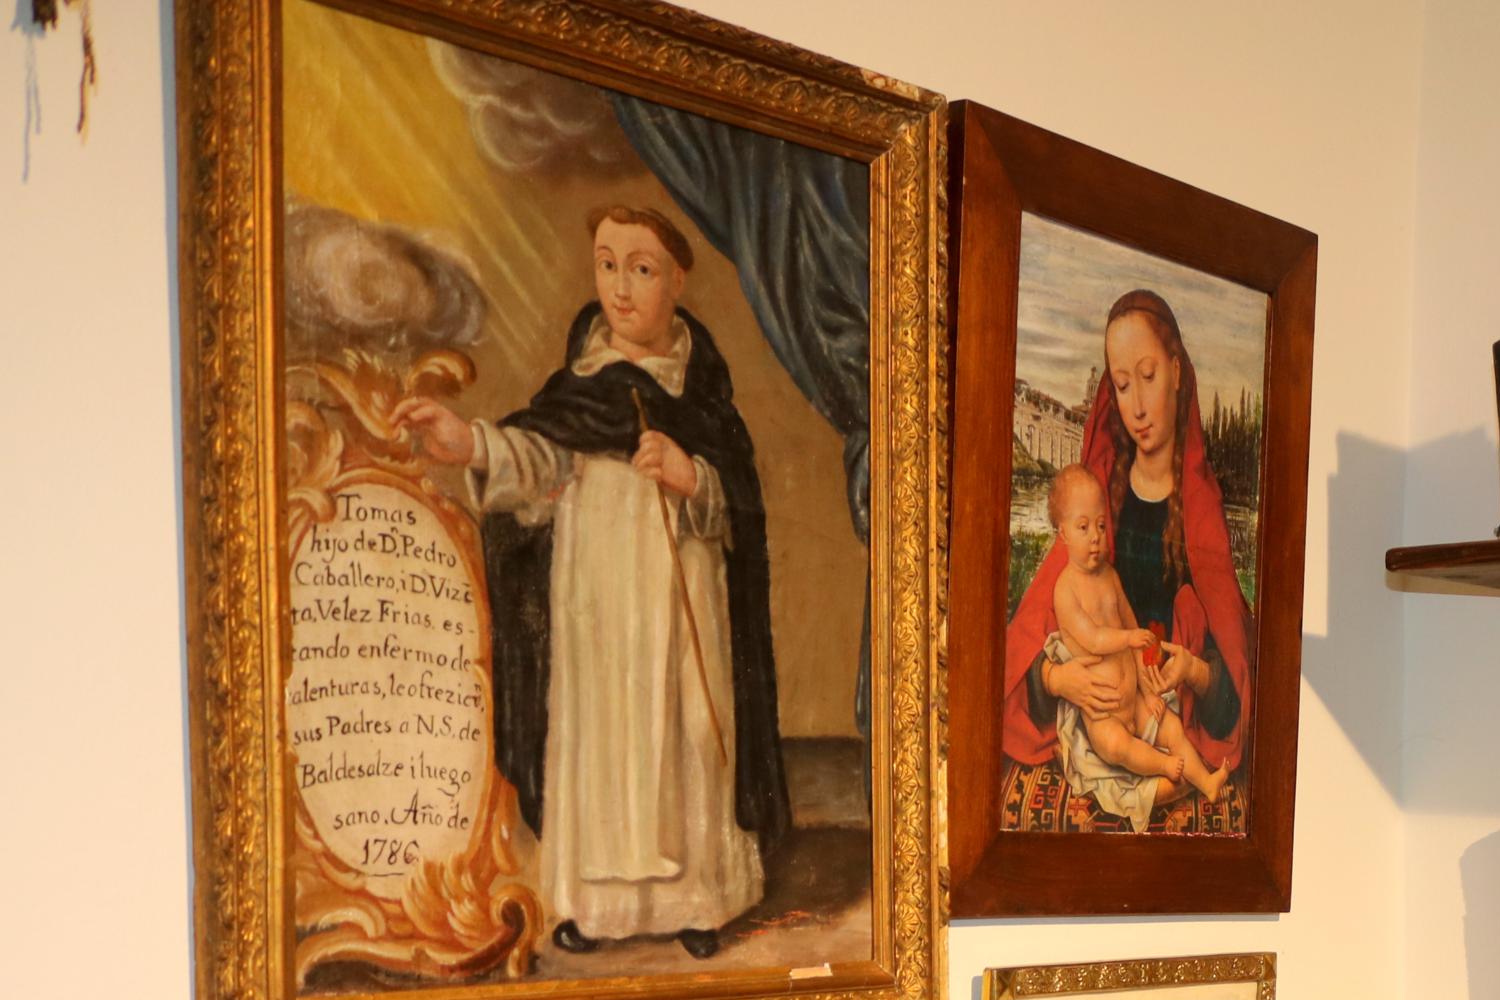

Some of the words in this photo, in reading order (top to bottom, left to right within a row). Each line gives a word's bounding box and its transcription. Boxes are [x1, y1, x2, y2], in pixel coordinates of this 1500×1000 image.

[337, 494, 417, 526] Tomas
[311, 523, 349, 563] hijo
[354, 530, 376, 551] de
[401, 533, 457, 569] Pedro
[315, 595, 373, 624] Velez
[358, 633, 448, 669] enfermo
[450, 644, 472, 673] de
[389, 672, 406, 697] le
[293, 727, 323, 747] sus
[325, 709, 392, 738] Padres
[399, 719, 410, 734] a
[458, 720, 481, 743] de
[420, 750, 473, 798] luego
[391, 788, 444, 826] Año
[447, 802, 470, 830] de
